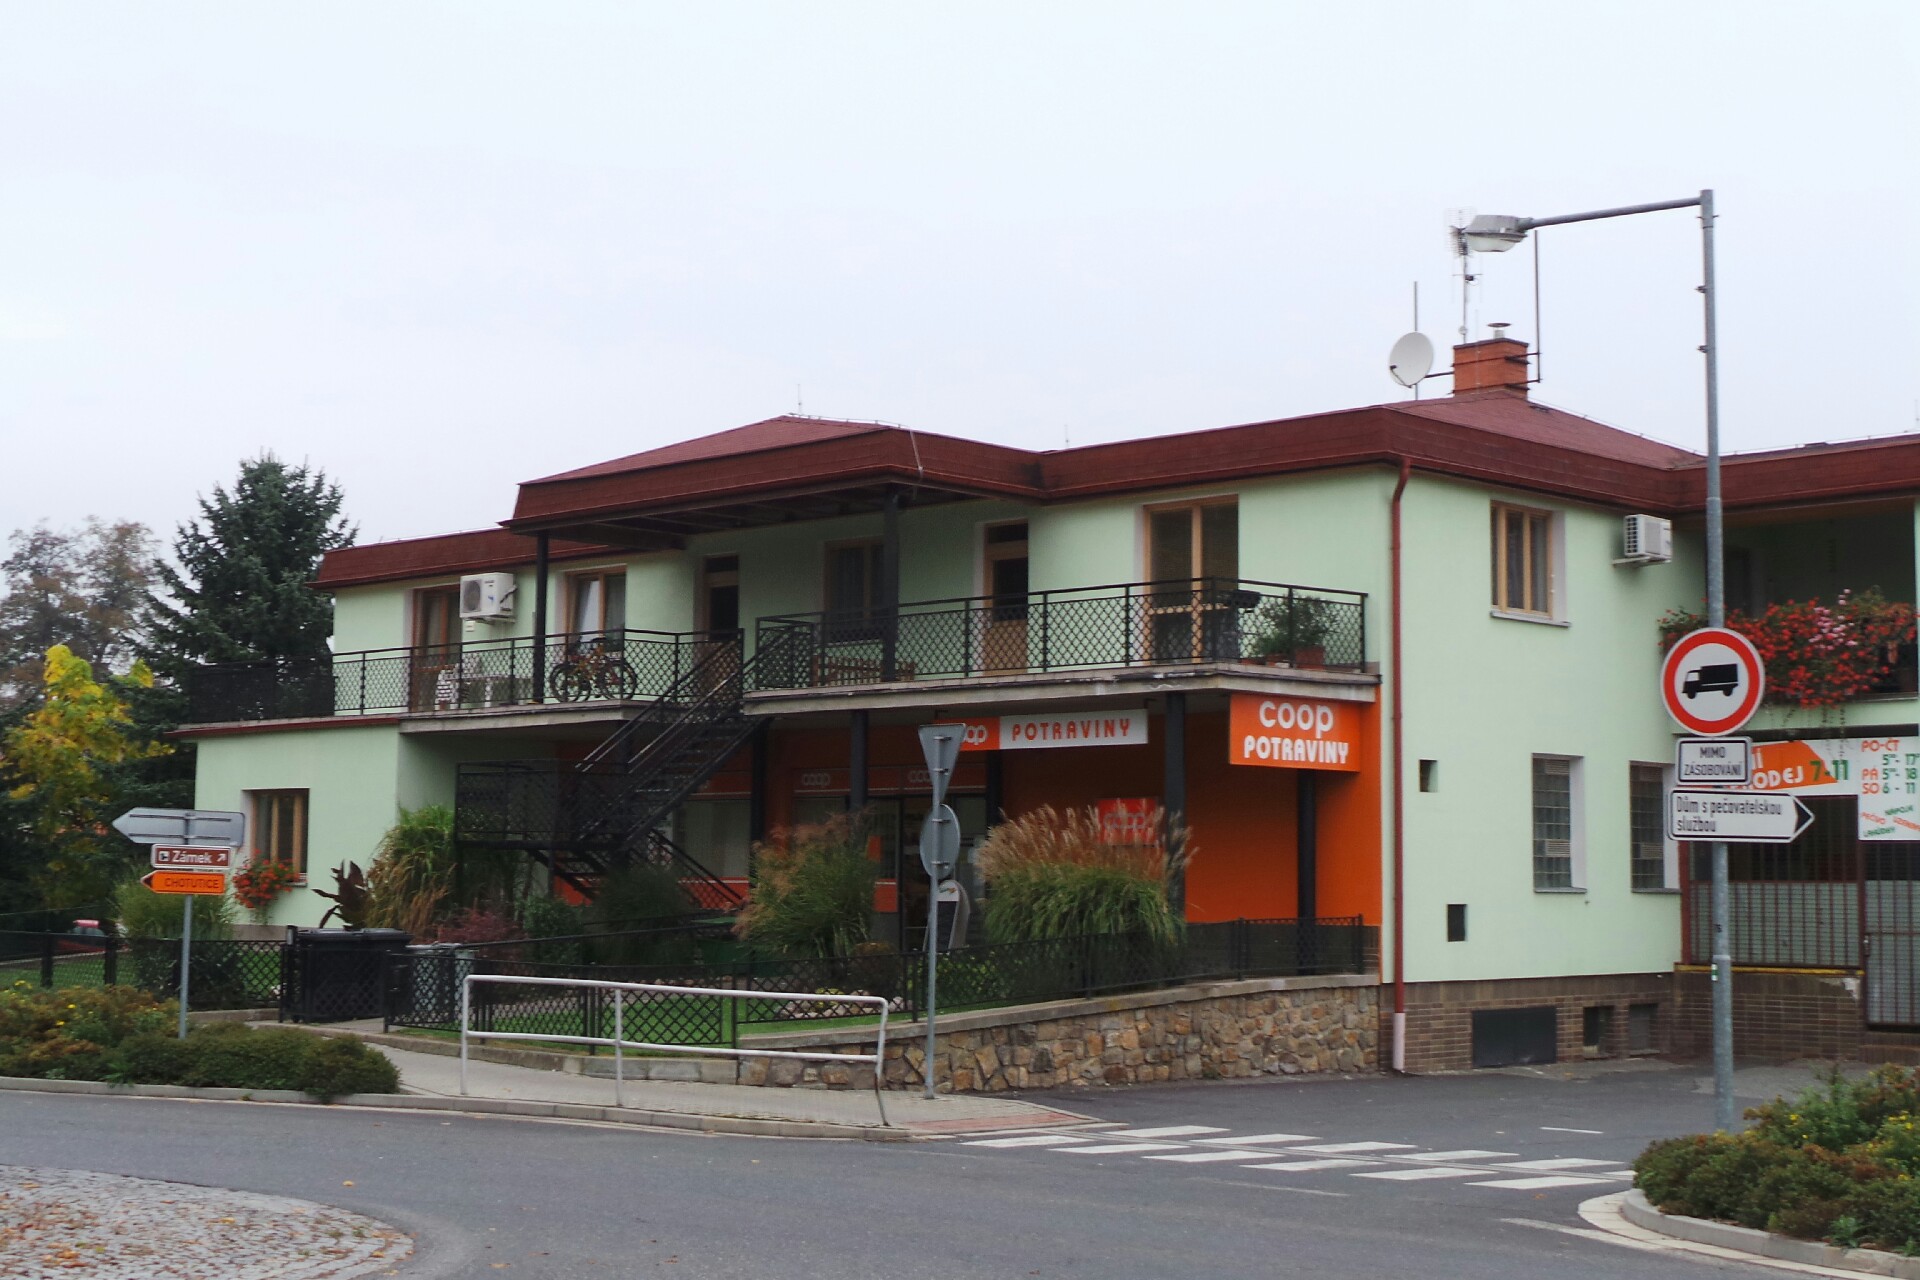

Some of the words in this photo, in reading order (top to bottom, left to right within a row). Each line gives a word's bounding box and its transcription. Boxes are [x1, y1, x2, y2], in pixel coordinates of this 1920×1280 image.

[1012, 718, 1131, 741] POTRAVINY
[1244, 735, 1349, 764] POTRAVINY
[1699, 746, 1726, 758] MIMO
[1684, 761, 1741, 776] ZÁSOBOVÁNÍ
[1752, 766, 1804, 789] ODEJ
[1862, 782, 1880, 795] SO
[1905, 781, 1916, 794] 11
[1676, 796, 1698, 812] Dům
[1702, 802, 1707, 813] s
[1710, 798, 1782, 817] pečovatelskou
[1677, 815, 1716, 832] službou
[171, 850, 213, 864] Zámek
[165, 877, 219, 889] CHOTUTICE
